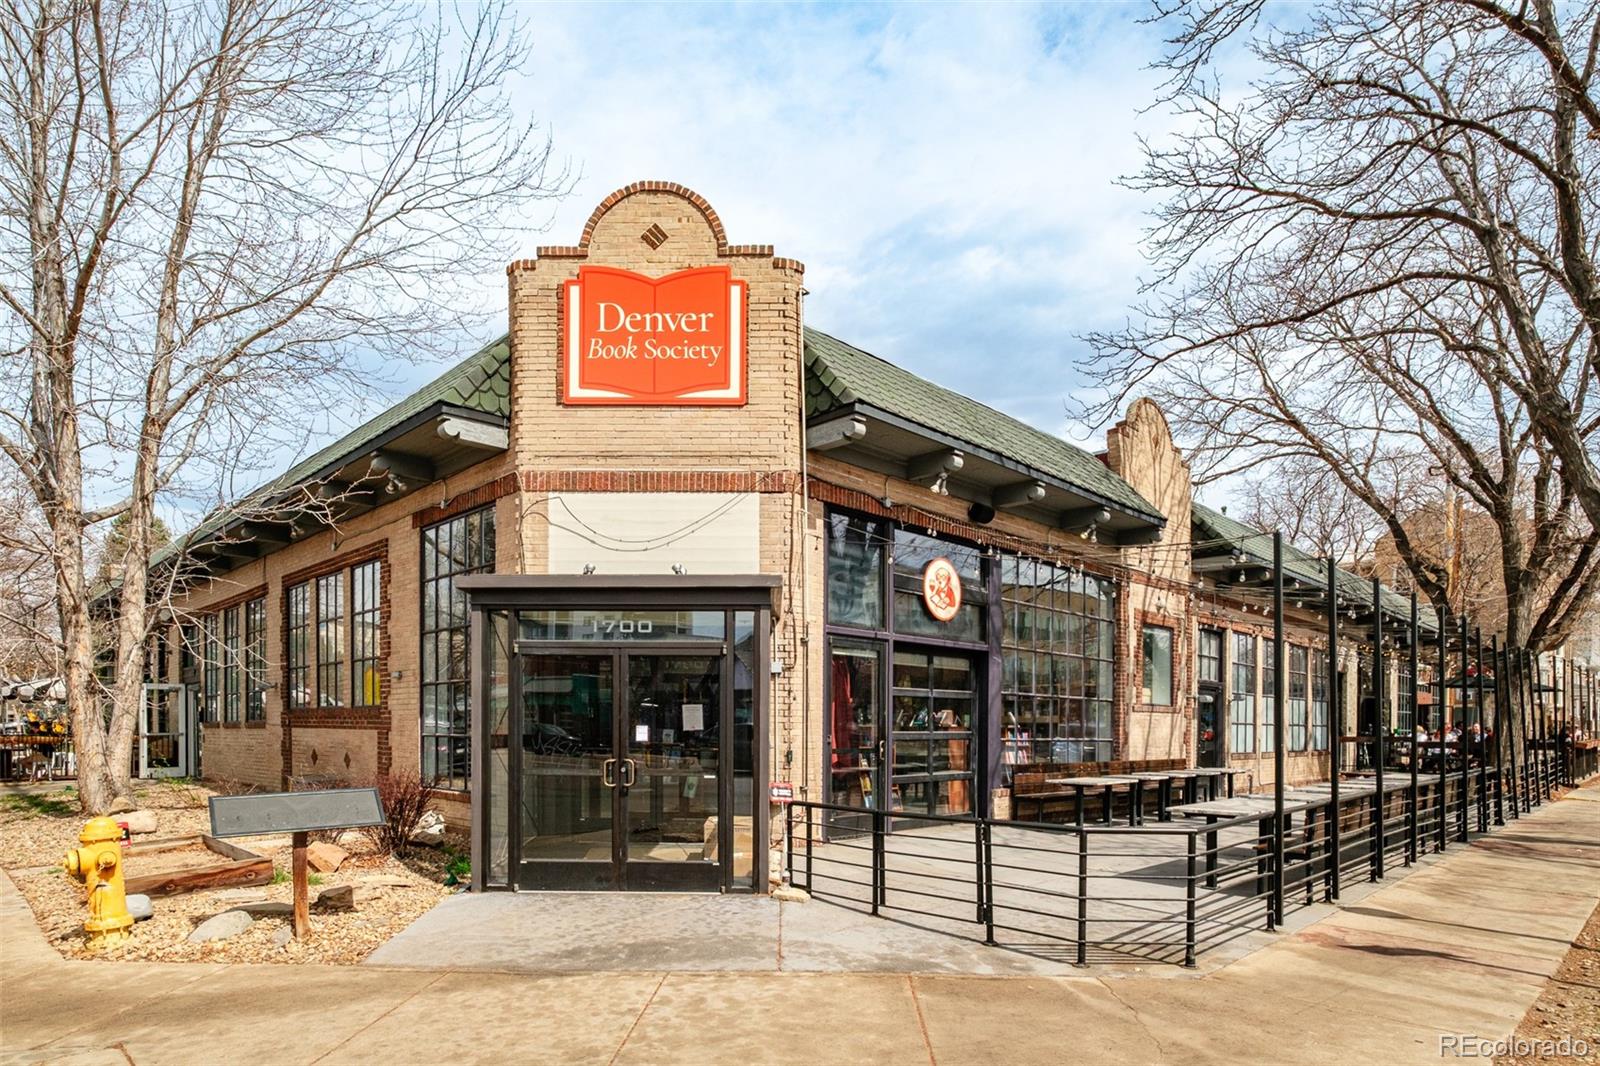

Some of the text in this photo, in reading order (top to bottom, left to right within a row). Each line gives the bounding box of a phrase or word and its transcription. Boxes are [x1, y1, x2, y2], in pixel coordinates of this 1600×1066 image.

[597, 302, 714, 332] Denver
[588, 336, 723, 367] Book Society
[592, 620, 652, 633] 1700
